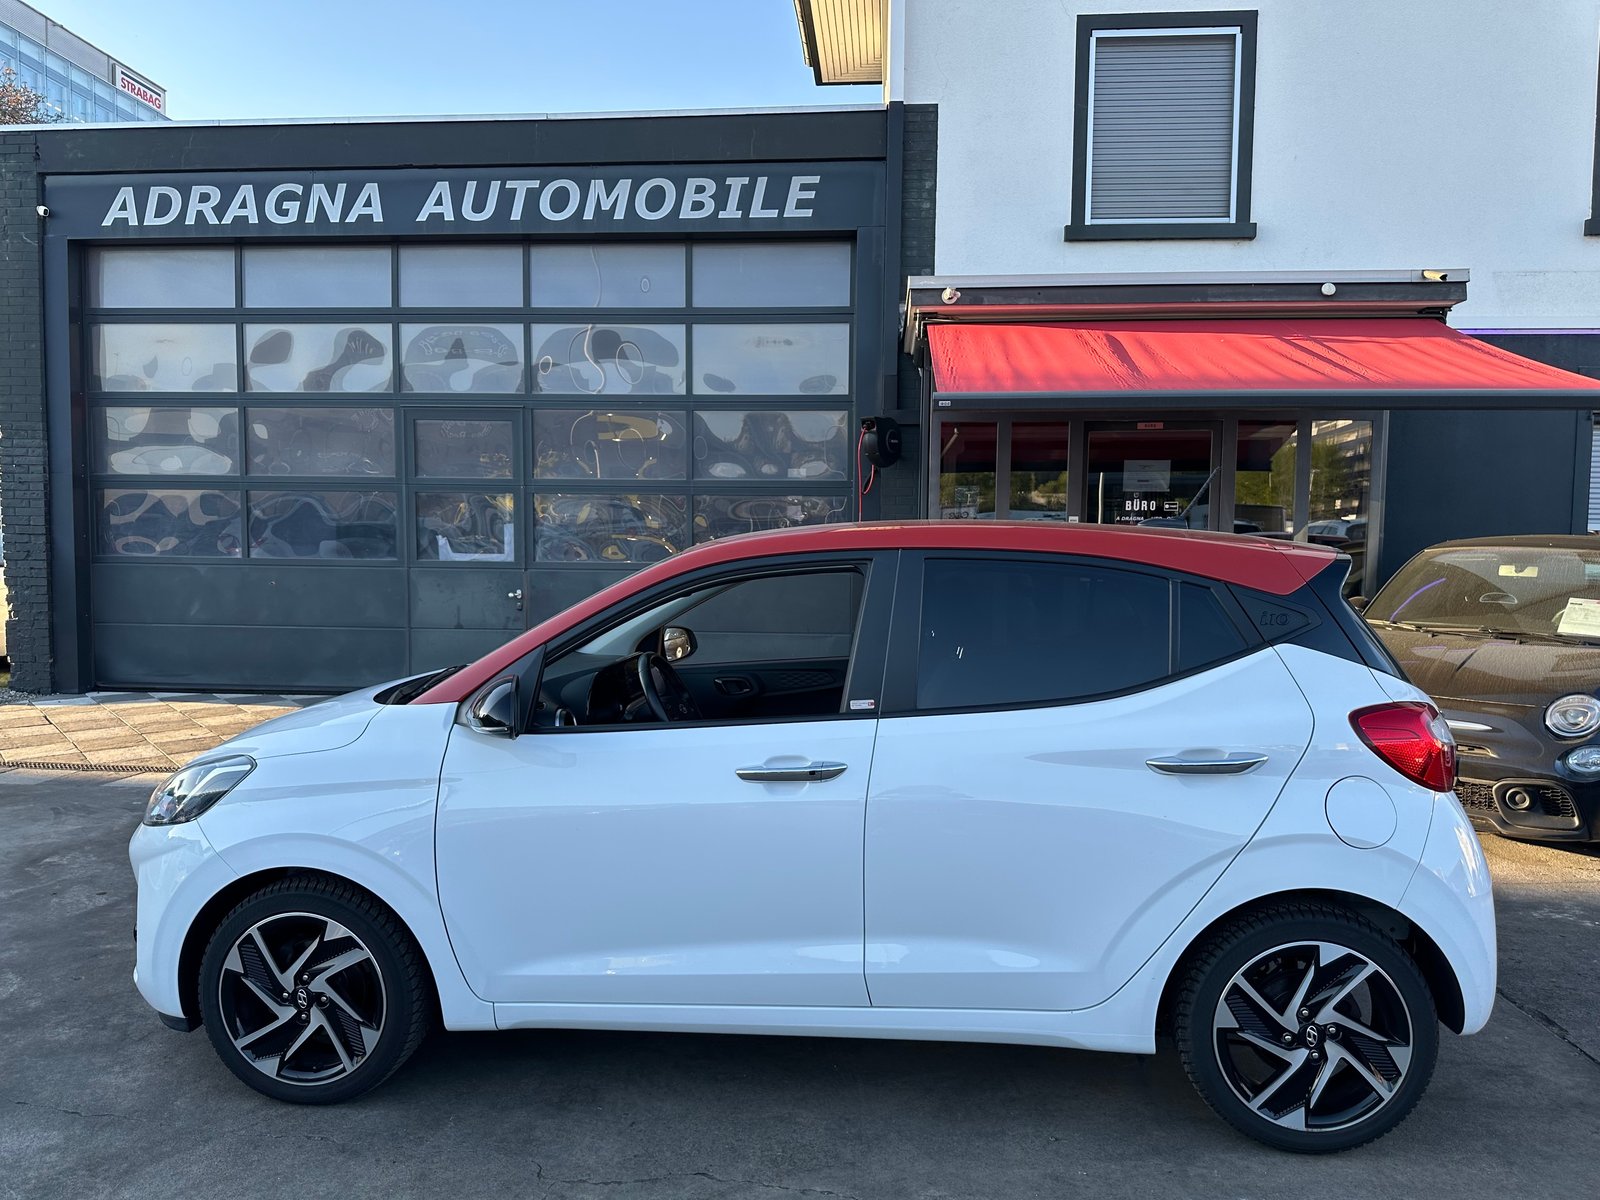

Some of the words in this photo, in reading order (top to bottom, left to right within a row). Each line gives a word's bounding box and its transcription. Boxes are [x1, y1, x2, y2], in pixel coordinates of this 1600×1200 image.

[121, 77, 161, 109] STRABAG
[101, 182, 384, 227] ADRAGNA
[415, 175, 821, 222] AUTOMOBILE
[1125, 499, 1156, 511] BÜRO
